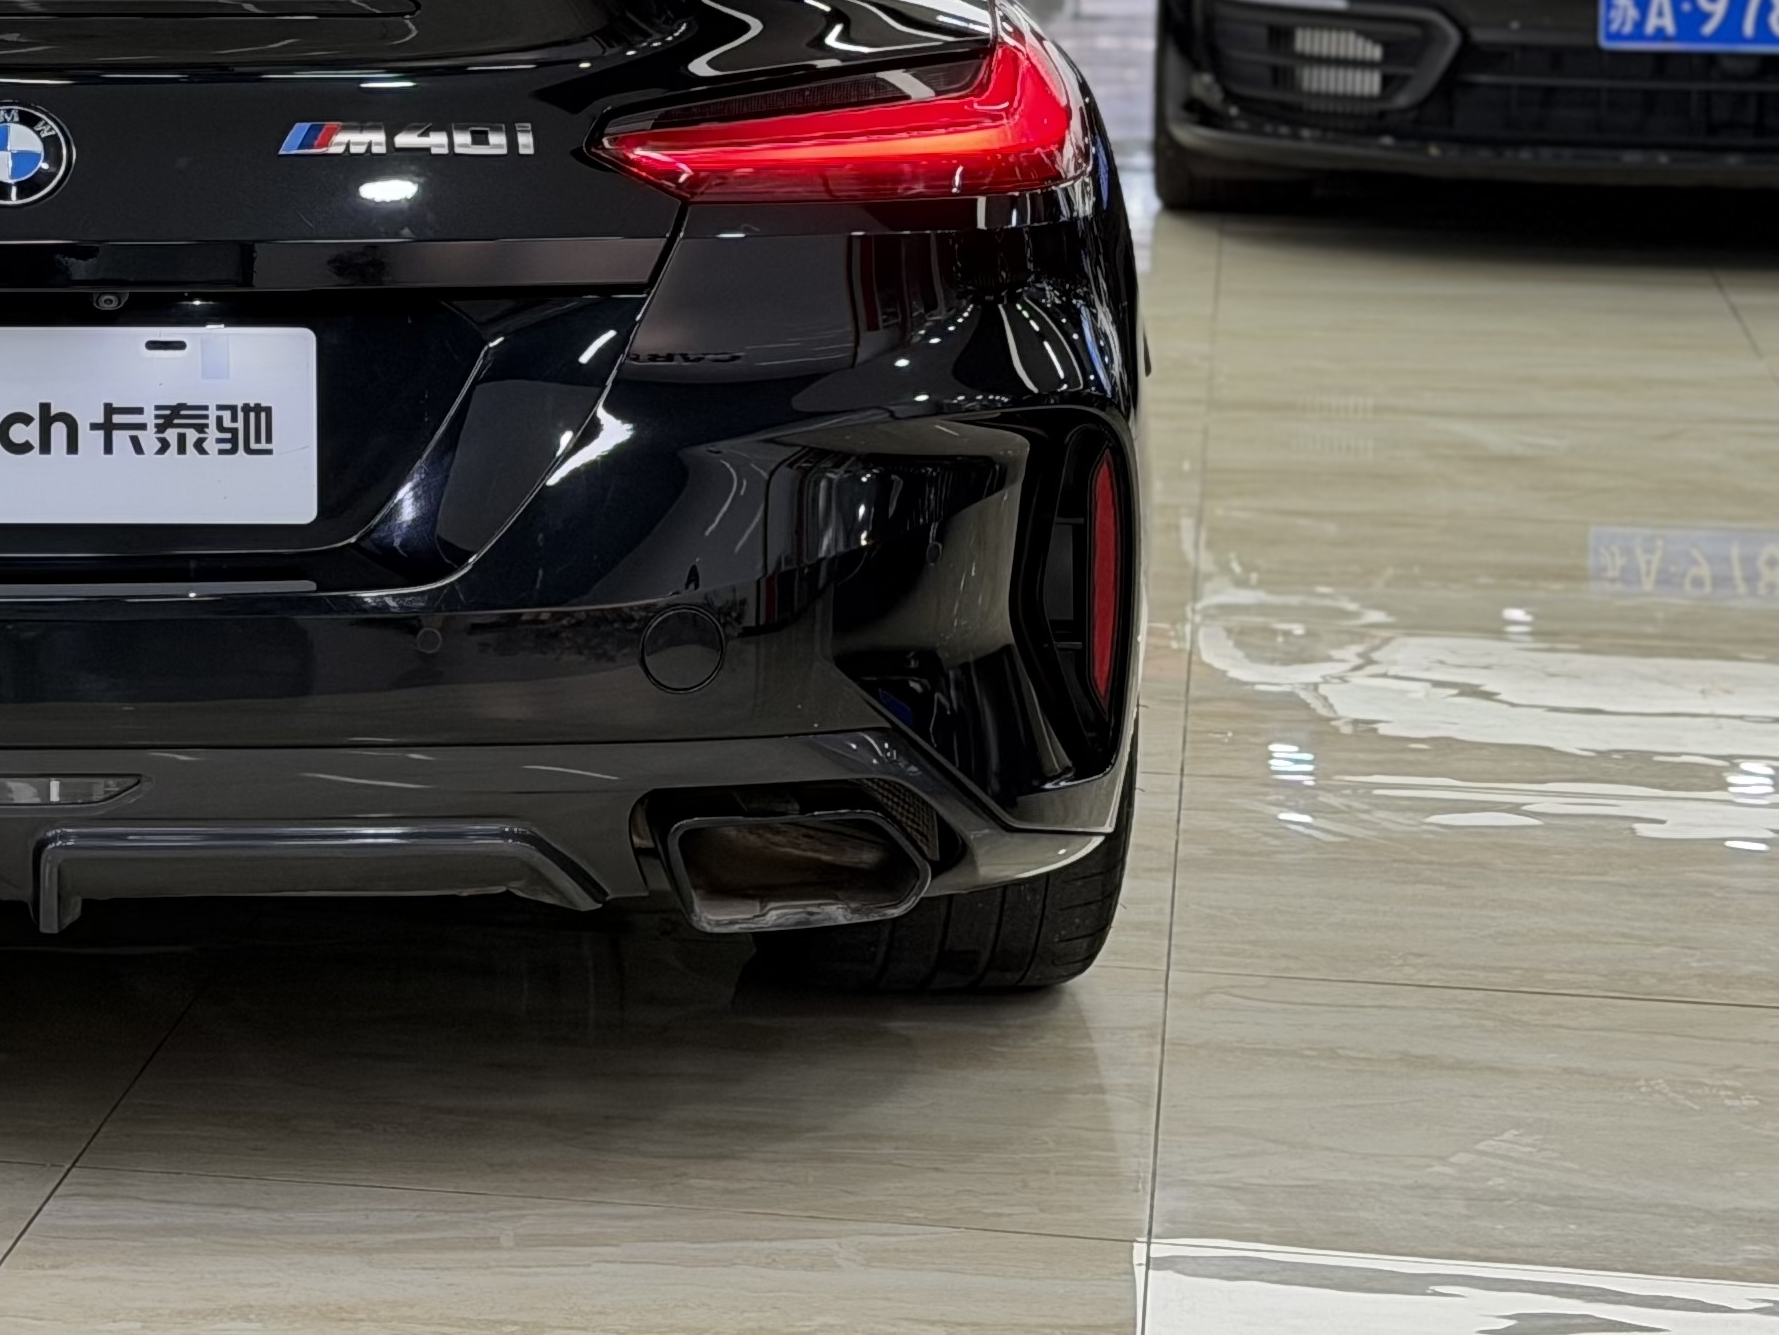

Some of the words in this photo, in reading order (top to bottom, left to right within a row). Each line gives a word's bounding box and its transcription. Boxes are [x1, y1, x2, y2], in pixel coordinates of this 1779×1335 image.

[278, 122, 535, 155] M40i
[88, 402, 275, 456] 卡泰驰
